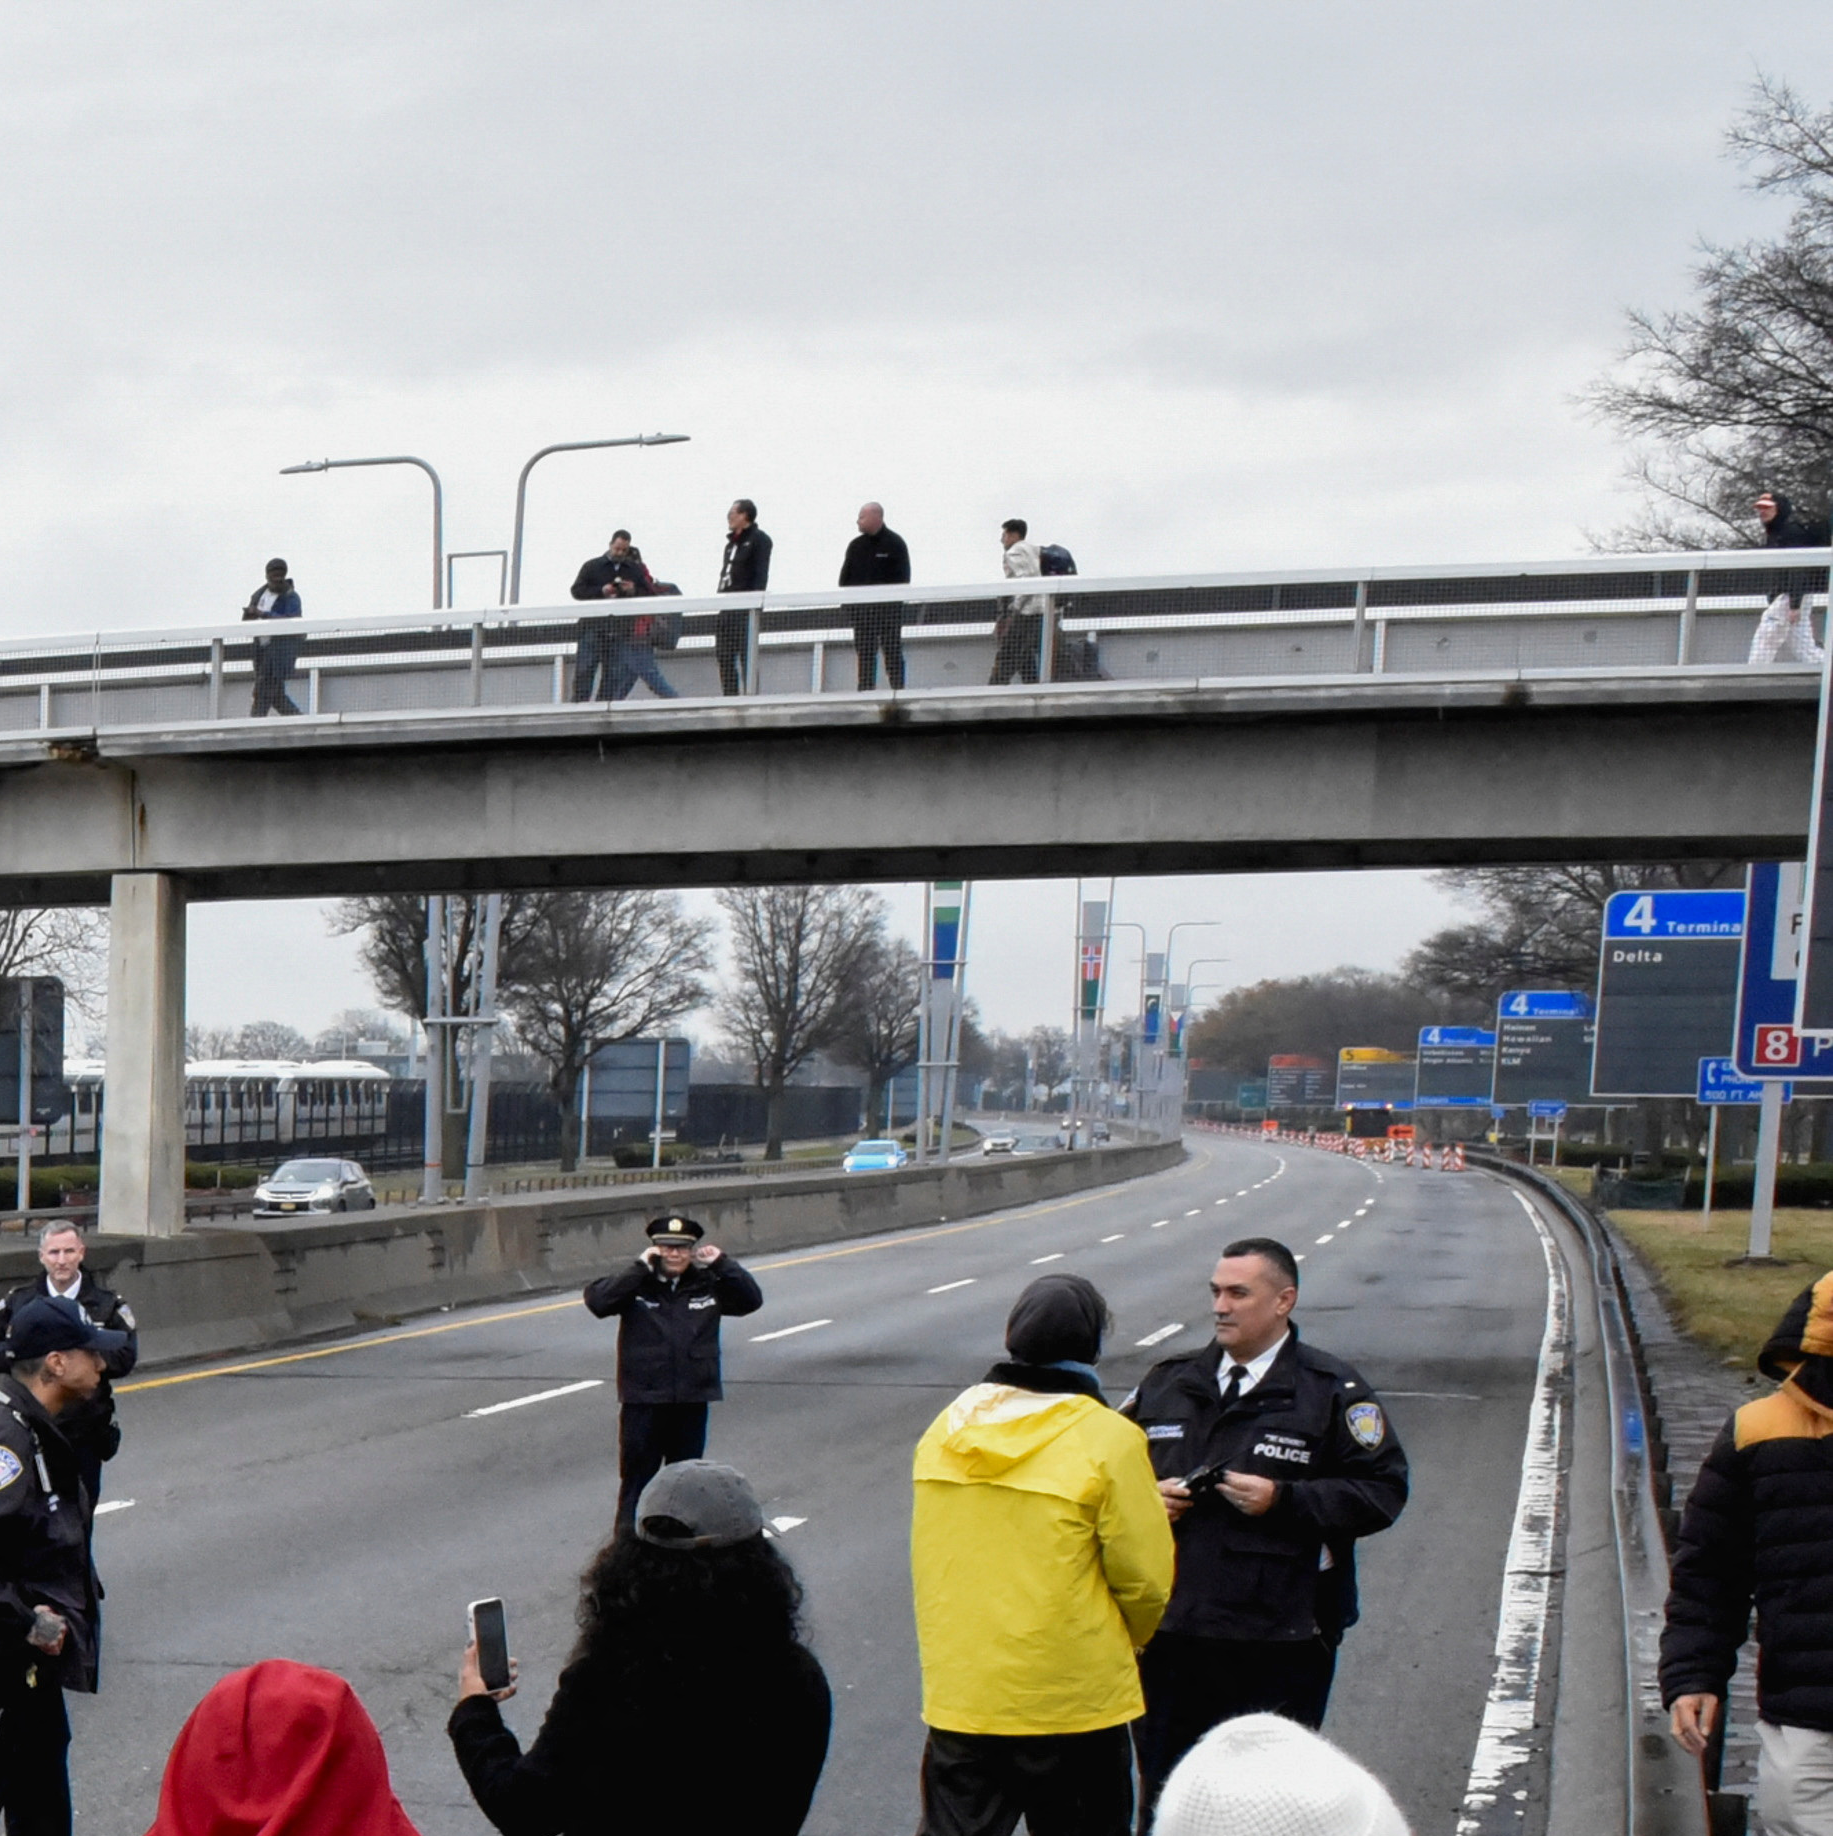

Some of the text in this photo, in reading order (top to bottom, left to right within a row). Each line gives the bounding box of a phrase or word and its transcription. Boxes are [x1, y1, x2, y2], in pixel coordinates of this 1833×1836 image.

[1623, 896, 1744, 934] 4 Termina
[1613, 950, 1663, 963] Delta
[1509, 993, 1529, 1015] 4
[1426, 1028, 1441, 1044] 4
[1501, 1046, 1532, 1056] Kenya
[1765, 1030, 1789, 1060] 8
[1501, 1058, 1521, 1066] KLM
[1731, 1090, 1744, 1100] FT
[1253, 1443, 1312, 1464] POLICE
